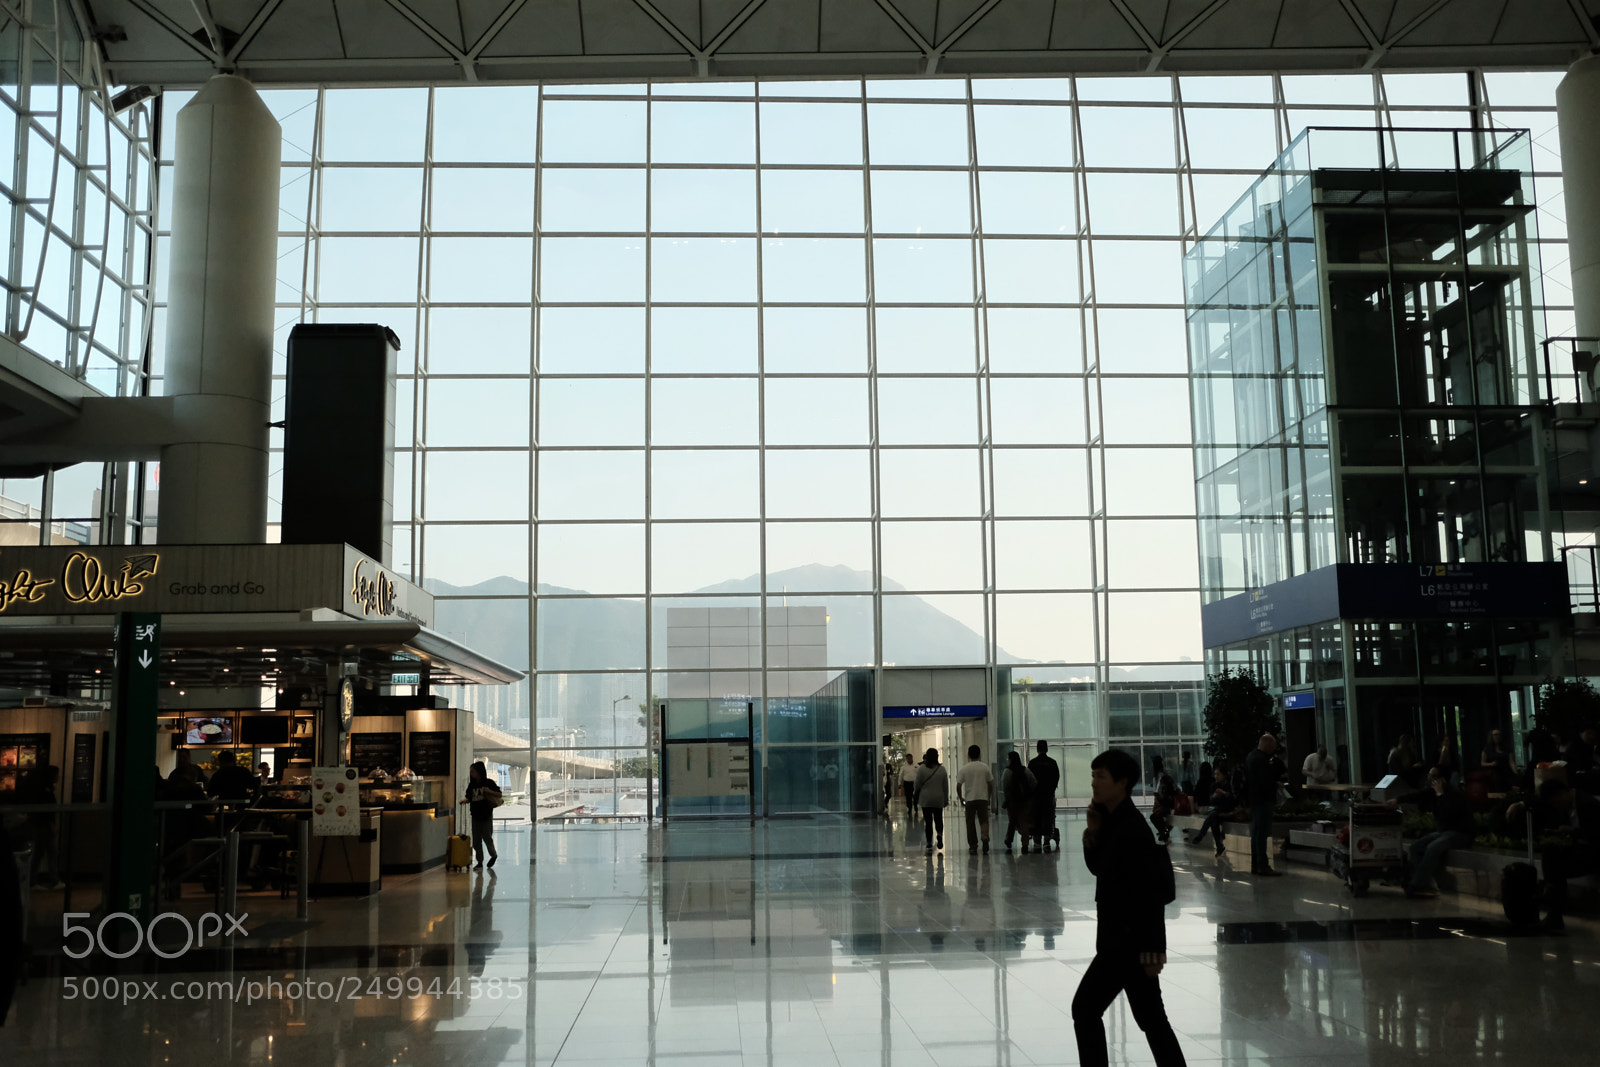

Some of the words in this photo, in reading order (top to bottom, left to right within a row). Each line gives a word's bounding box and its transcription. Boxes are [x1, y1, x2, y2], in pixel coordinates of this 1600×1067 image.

[61, 552, 142, 602] Club
[1419, 564, 1433, 577] L7
[169, 582, 207, 595] Grab
[210, 582, 240, 595] and
[243, 582, 265, 595] Go
[1420, 584, 1436, 597] L6
[393, 674, 406, 684] EXIT
